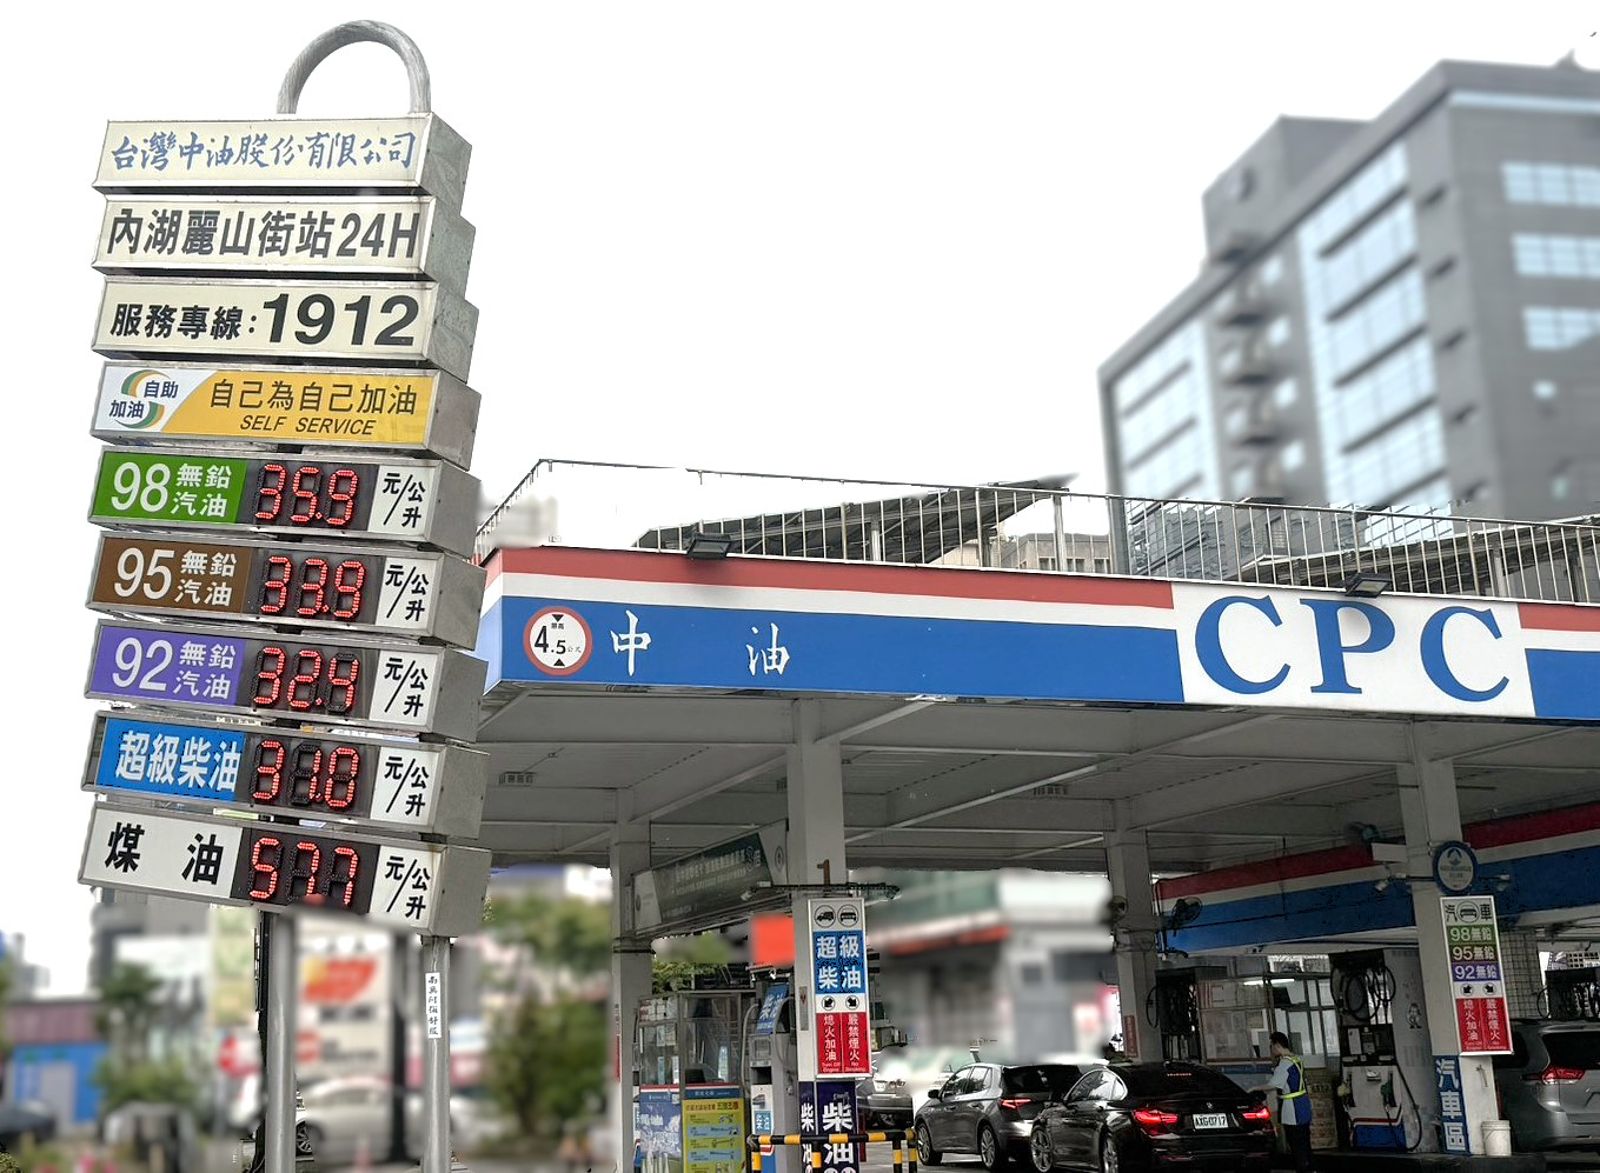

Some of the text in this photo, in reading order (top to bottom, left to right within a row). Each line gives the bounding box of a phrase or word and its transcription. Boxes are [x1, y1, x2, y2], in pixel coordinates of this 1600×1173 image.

[111, 130, 416, 171] 台灣中油股份有限公司
[143, 380, 179, 399] 自助
[210, 378, 417, 415] 自己為自己加油
[109, 400, 145, 419] 加油
[240, 415, 377, 436] SELF SERVICE
[110, 461, 172, 513] 98
[176, 463, 233, 489] 無鉛
[171, 491, 228, 519] 汽油
[254, 464, 360, 526] 35.9
[114, 547, 176, 600] 95
[181, 550, 237, 577] 無鉛
[175, 579, 232, 608] 汽油
[261, 556, 367, 619] 33.9
[111, 636, 173, 692] 92
[178, 640, 236, 669] 無鉛
[1195, 594, 1510, 703] CPC
[173, 669, 231, 700] 汽油
[114, 729, 242, 793] 超級柴油
[252, 740, 361, 808] 31.0
[816, 934, 860, 959] 超級
[819, 964, 862, 990] 柴油
[1436, 1058, 1466, 1152] 汽車區
